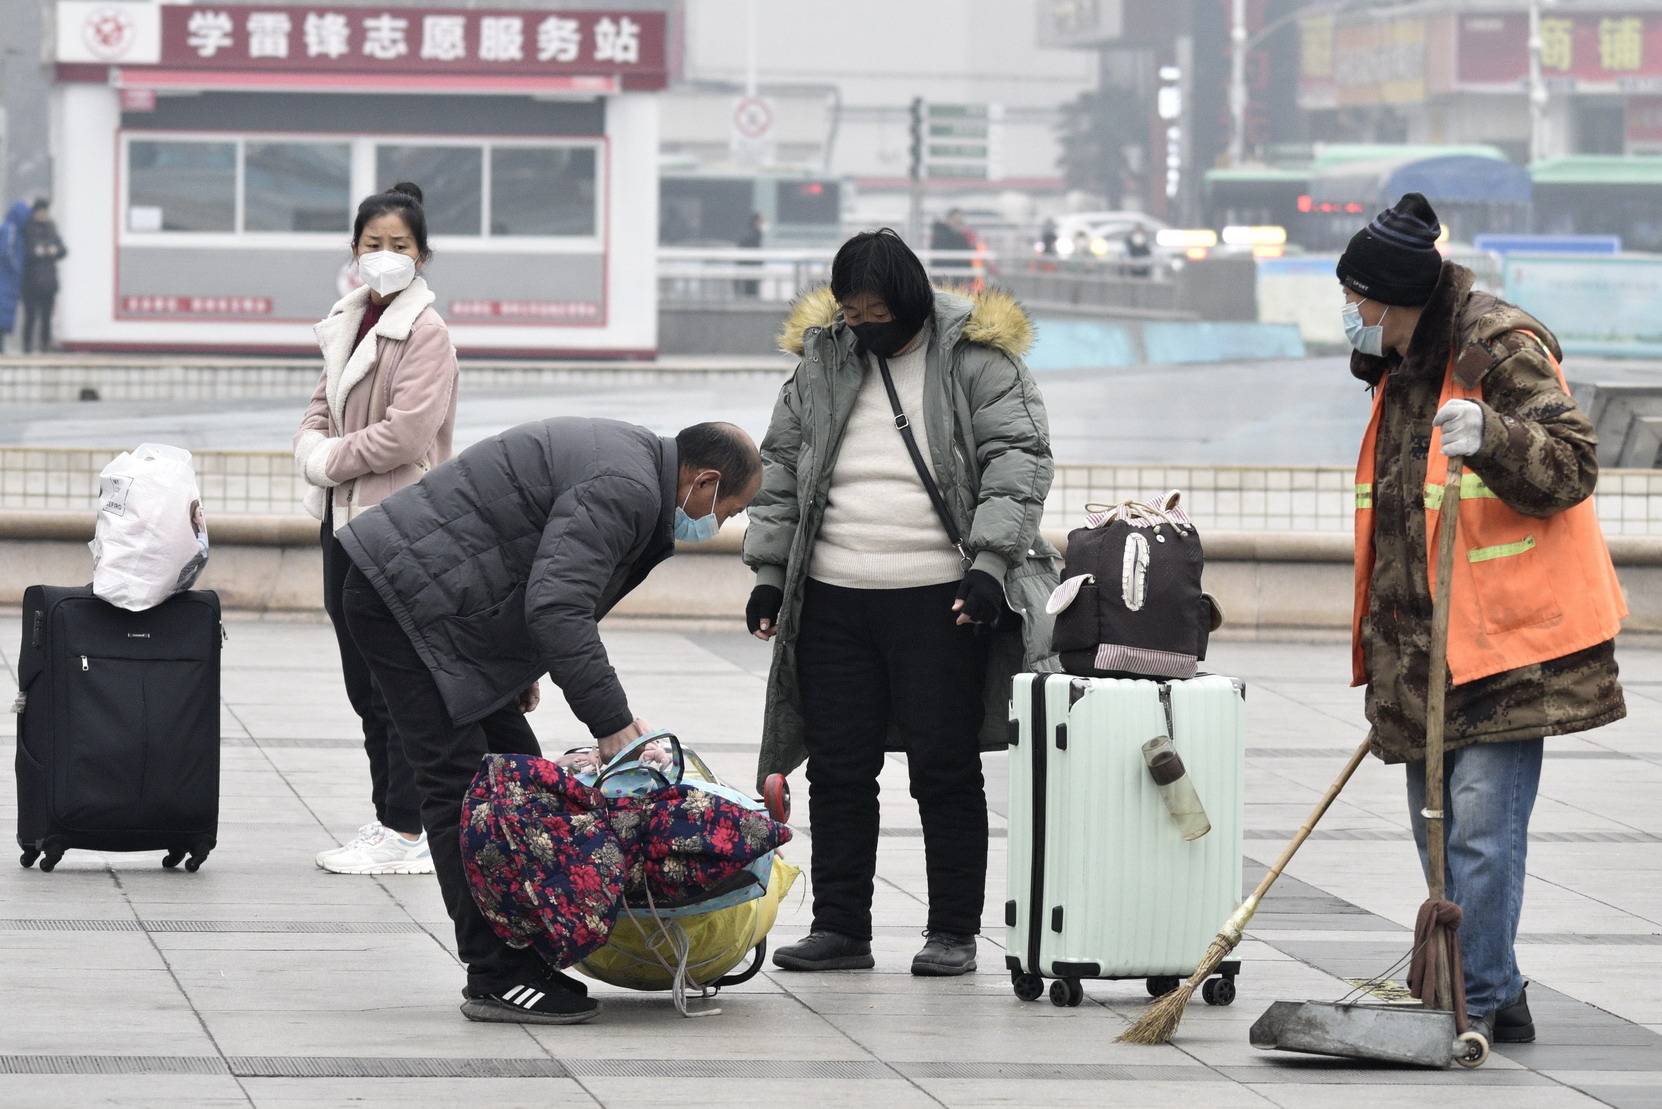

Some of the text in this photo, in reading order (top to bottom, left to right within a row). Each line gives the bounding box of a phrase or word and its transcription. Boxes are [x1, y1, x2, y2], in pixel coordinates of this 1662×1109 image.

[187, 11, 641, 63] 学雷锋志愿服务站
